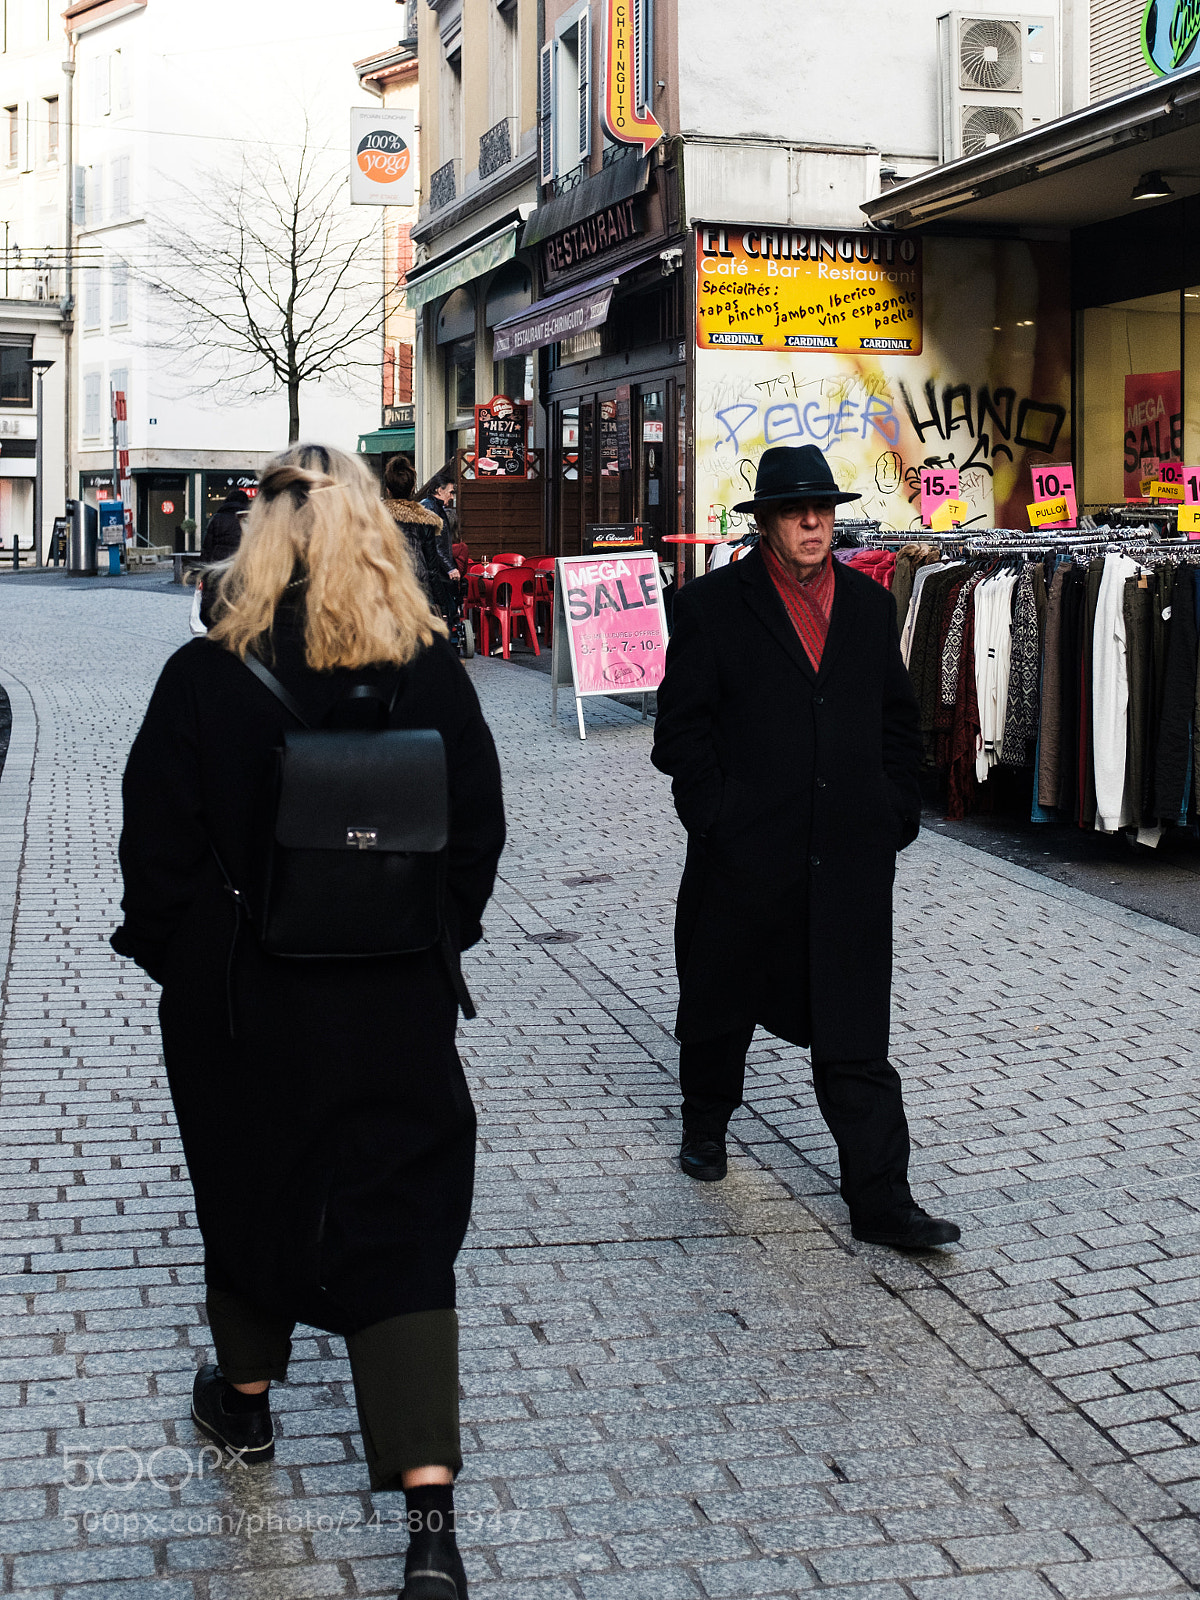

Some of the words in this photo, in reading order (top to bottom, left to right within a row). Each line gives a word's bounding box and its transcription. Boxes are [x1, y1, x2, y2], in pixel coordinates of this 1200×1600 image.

[616, 5, 626, 128] CHIRINGUITO
[366, 134, 401, 150] 100%
[362, 154, 408, 176] yoga
[547, 198, 636, 271] RESTAURANT
[702, 229, 734, 257] EL
[742, 230, 917, 265] CHIRINGUITO
[700, 257, 748, 276] Café
[766, 260, 801, 279] Bar
[818, 262, 917, 284] Restaurant
[699, 299, 739, 317] tapas
[728, 301, 780, 326] pinchos
[774, 302, 825, 328] jambon
[818, 310, 847, 327] vins
[852, 290, 917, 319] espagnols
[874, 307, 914, 330] paella
[514, 322, 545, 348] RESTAURANT
[712, 333, 761, 346] CARDINAL
[787, 336, 836, 348] CARDINAL
[863, 339, 910, 351] CARDINAL
[1126, 394, 1166, 429] MEGA
[1124, 413, 1182, 473] SALE
[923, 476, 957, 496] 15.-
[1036, 474, 1072, 498] 10.-
[1160, 466, 1182, 482] 10.-
[1157, 486, 1179, 495] PANTS
[567, 559, 632, 588] MEGA
[567, 572, 659, 621] SALE
[620, 641, 636, 652] 7.-
[640, 640, 662, 651] 10.-
